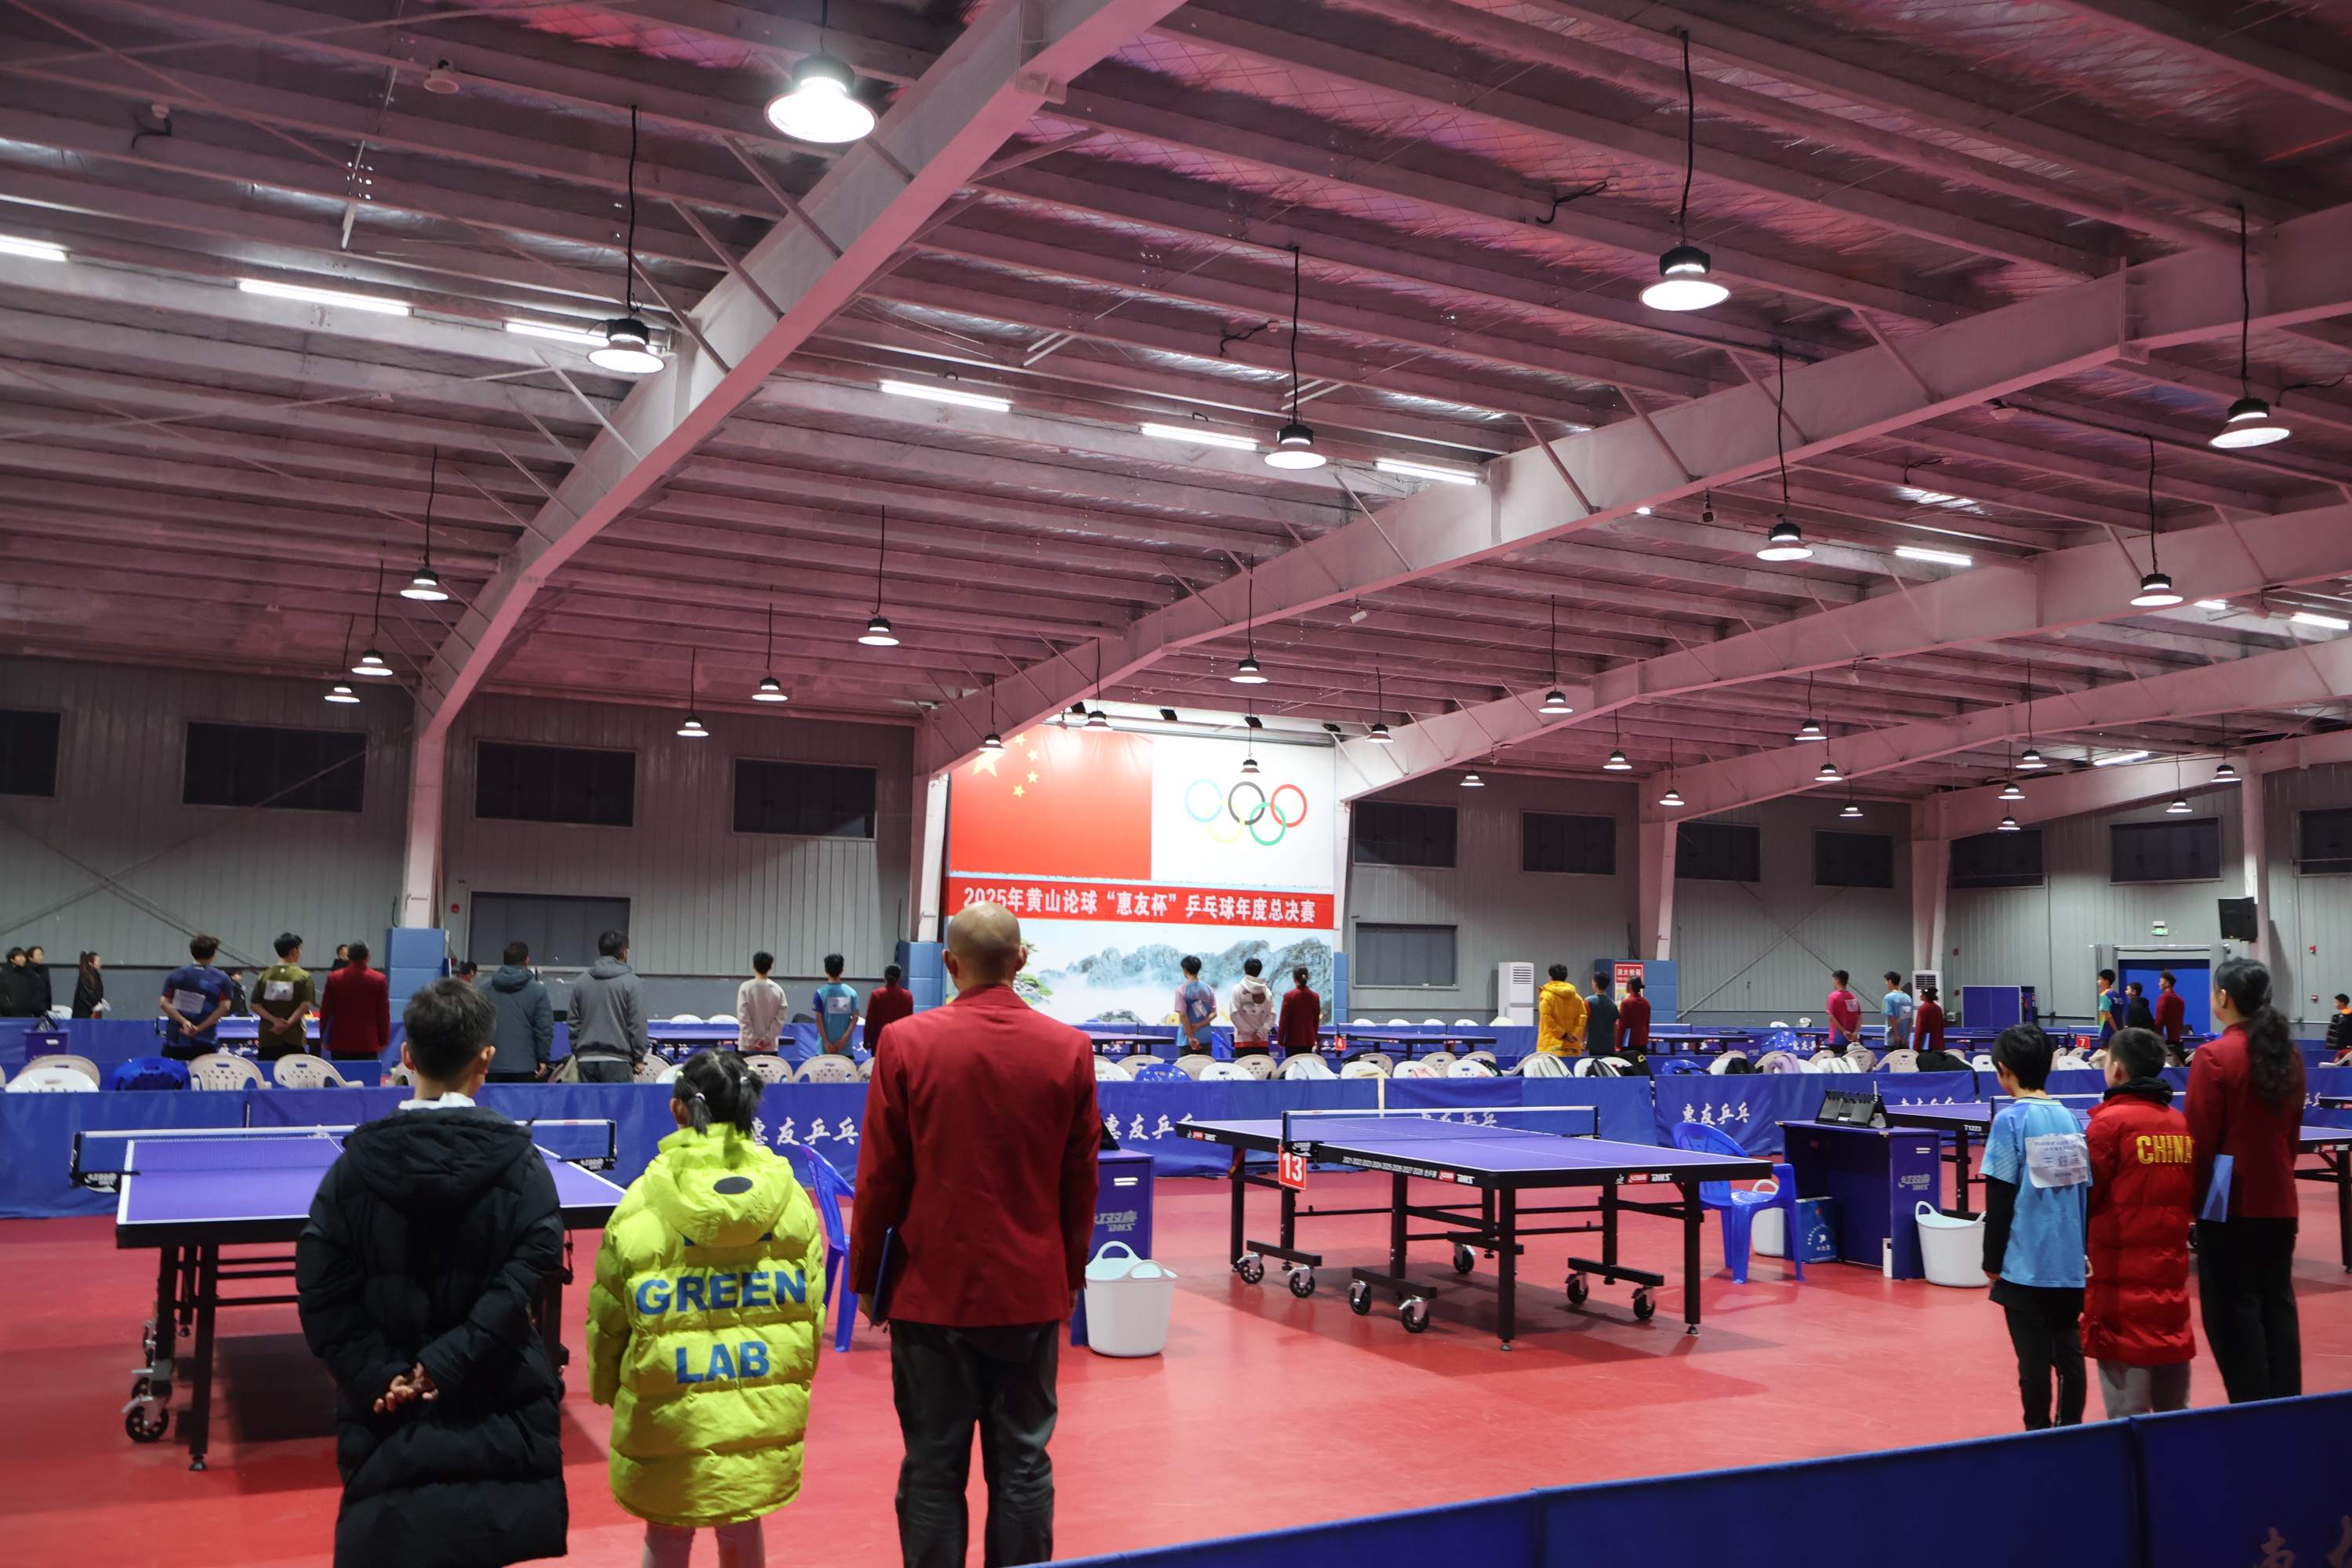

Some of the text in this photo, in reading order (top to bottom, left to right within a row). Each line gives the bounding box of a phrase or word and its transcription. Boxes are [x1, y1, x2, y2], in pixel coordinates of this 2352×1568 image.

[1104, 1113, 1192, 1140] 惠友乒
[1682, 1102, 1750, 1126] 惠友乒乓
[1283, 1152, 1302, 1182] 13
[636, 1270, 806, 1315] GREEN
[676, 1341, 770, 1384] LAB
